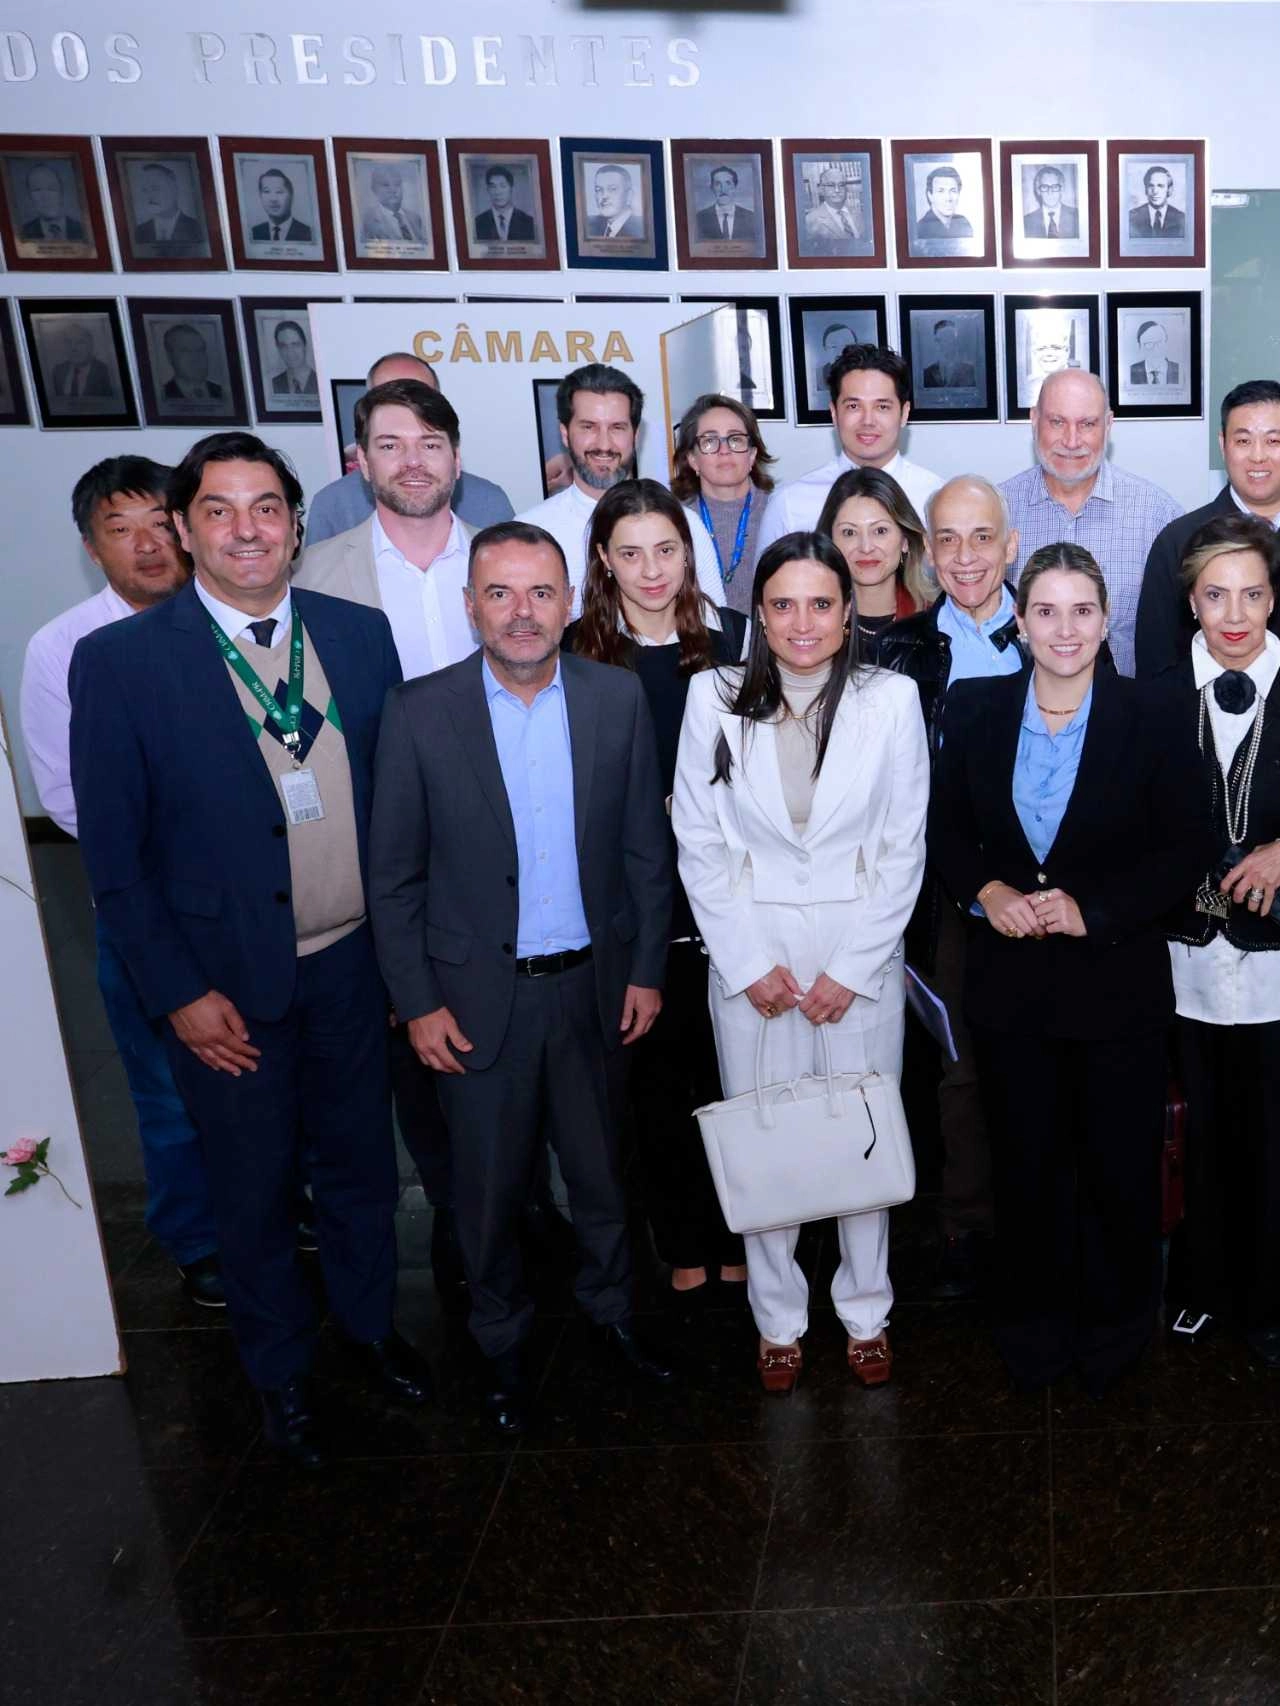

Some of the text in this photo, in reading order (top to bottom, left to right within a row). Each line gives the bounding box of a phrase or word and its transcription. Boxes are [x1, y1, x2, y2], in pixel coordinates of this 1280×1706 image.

[0, 30, 702, 88] DOS PRESIDENTES
[412, 322, 635, 364] CÂMARA
